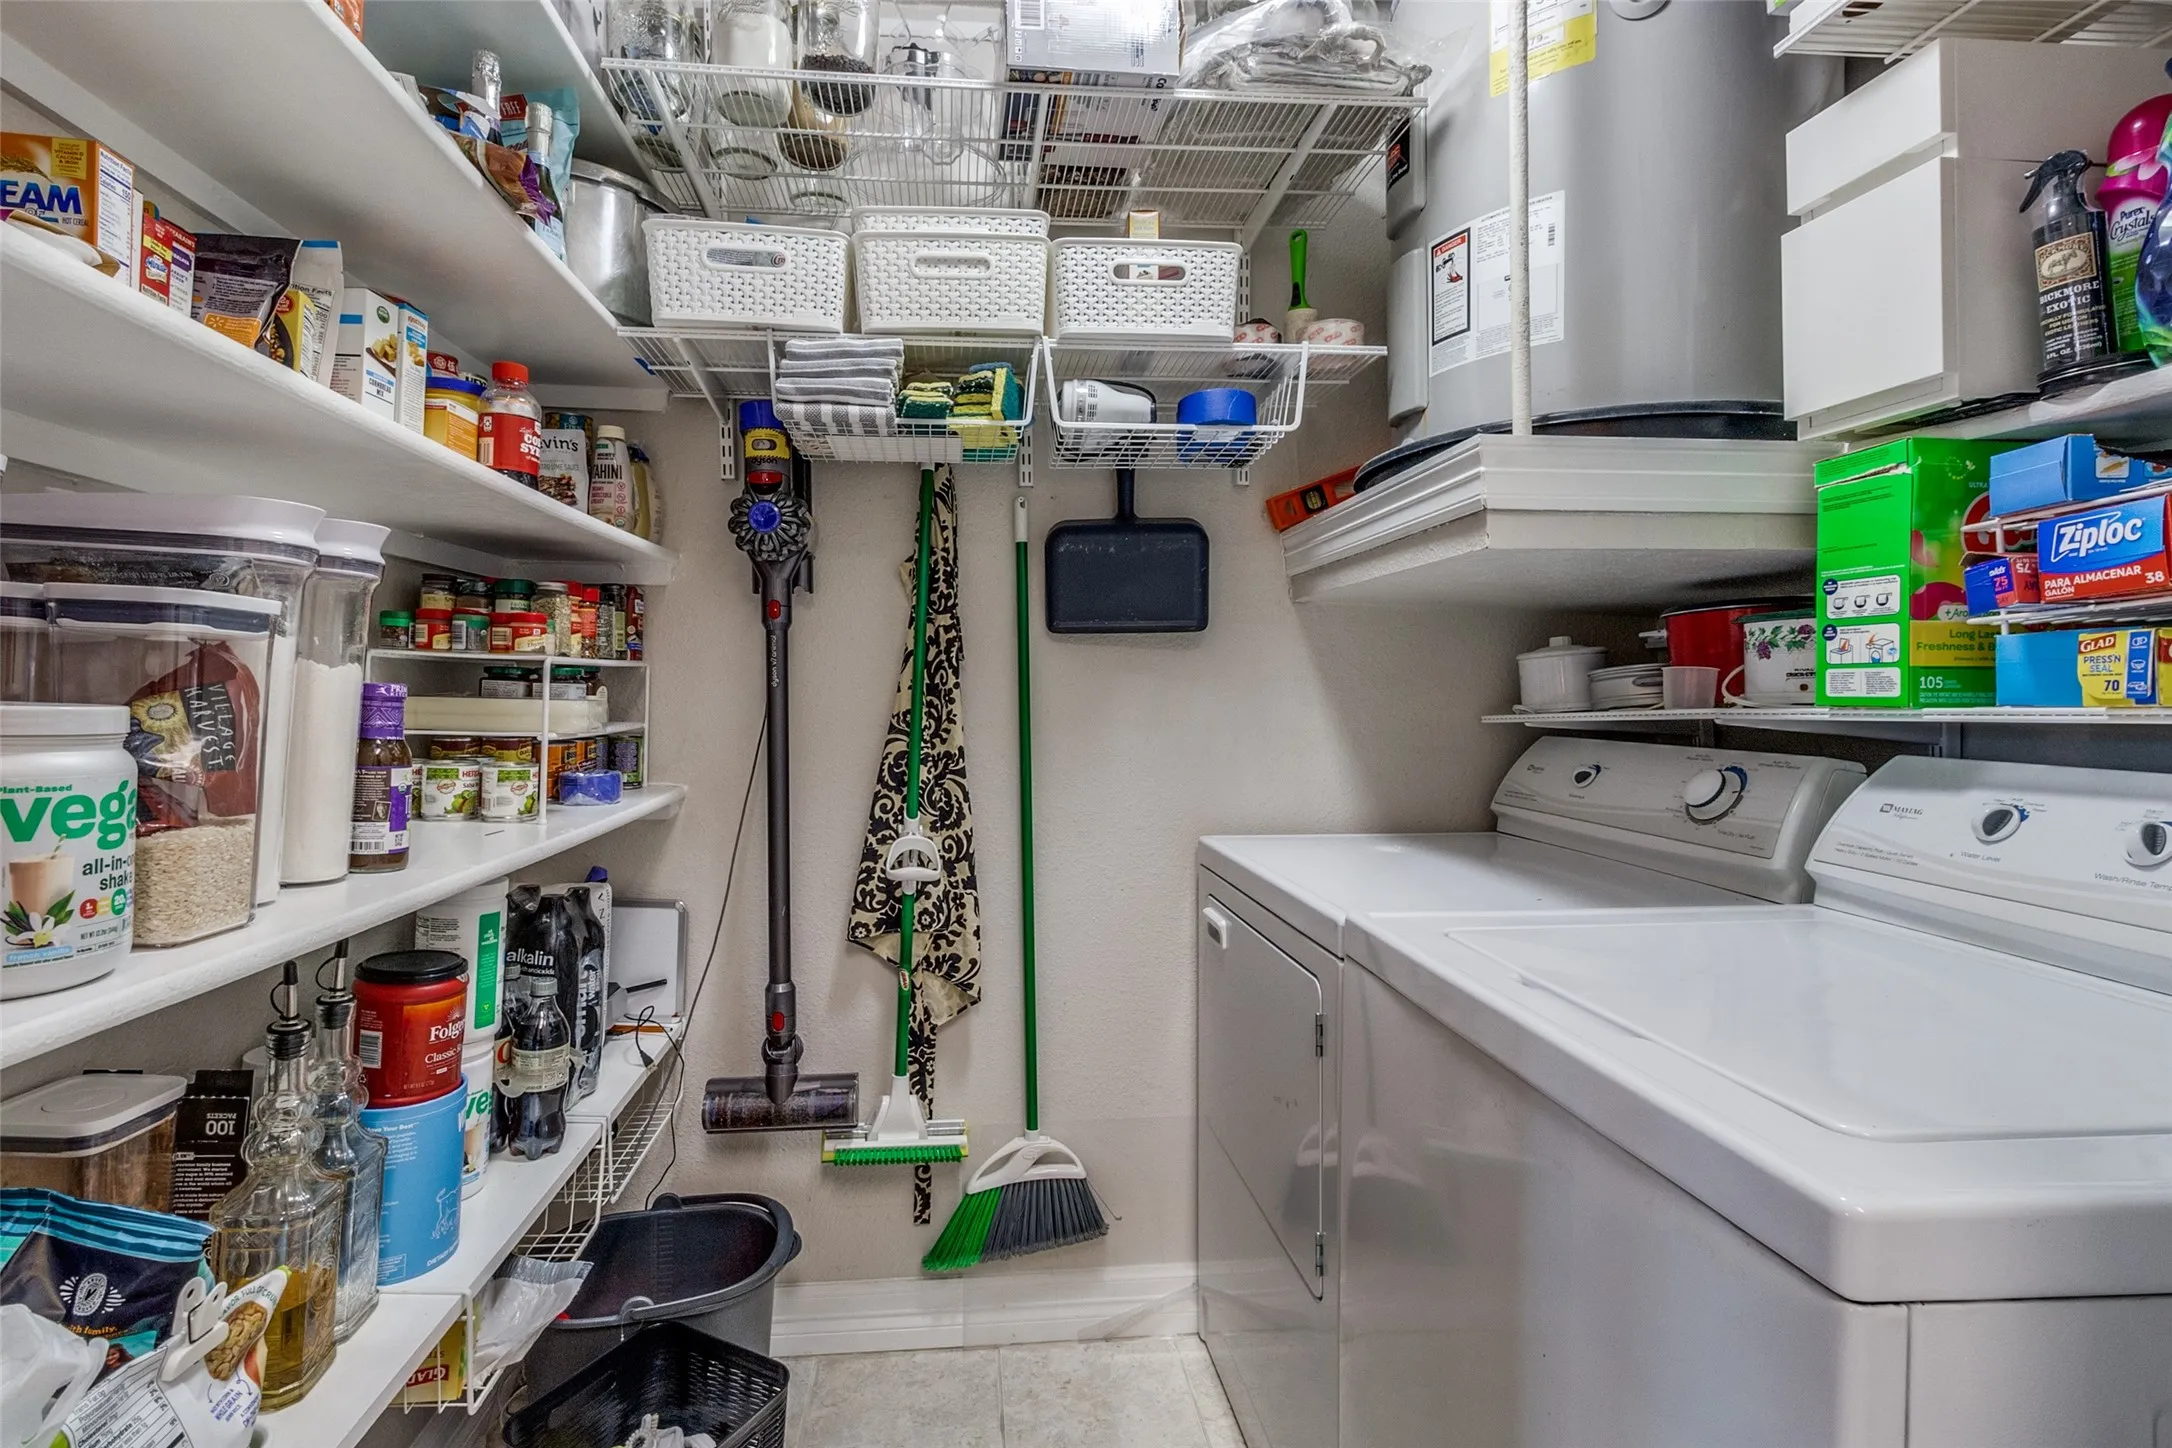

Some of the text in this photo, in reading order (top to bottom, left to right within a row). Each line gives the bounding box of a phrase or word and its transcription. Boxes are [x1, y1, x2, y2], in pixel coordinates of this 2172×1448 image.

[501, 101, 522, 116] FREE
[2120, 207, 2144, 221] Purex
[1441, 238, 1463, 254] DANGER
[2040, 280, 2100, 304] BICKMORE
[2058, 517, 2143, 558] Ziploc
[1994, 576, 2009, 587] 75
[2044, 564, 2142, 590] PARA ALMACENAR
[2145, 570, 2165, 584] 38
[2044, 584, 2075, 597] GALÓN
[1949, 630, 1976, 641] Long
[1916, 641, 1975, 651] Freshness
[2080, 636, 2115, 653] GLAD
[2083, 654, 2121, 664] PRESS'N
[2089, 664, 2113, 673] SEAL
[1919, 675, 1943, 688] 105
[2104, 680, 2120, 691] 70
[207, 684, 236, 761] VILLAGE
[1960, 850, 2001, 863] Water Level
[2094, 872, 2147, 887] Wash/Rinse
[424, 1047, 455, 1065] Classic
[205, 1120, 236, 1136] 100
[226, 1391, 243, 1408] GRAIN
[77, 1420, 108, 1447] Cholesterol
